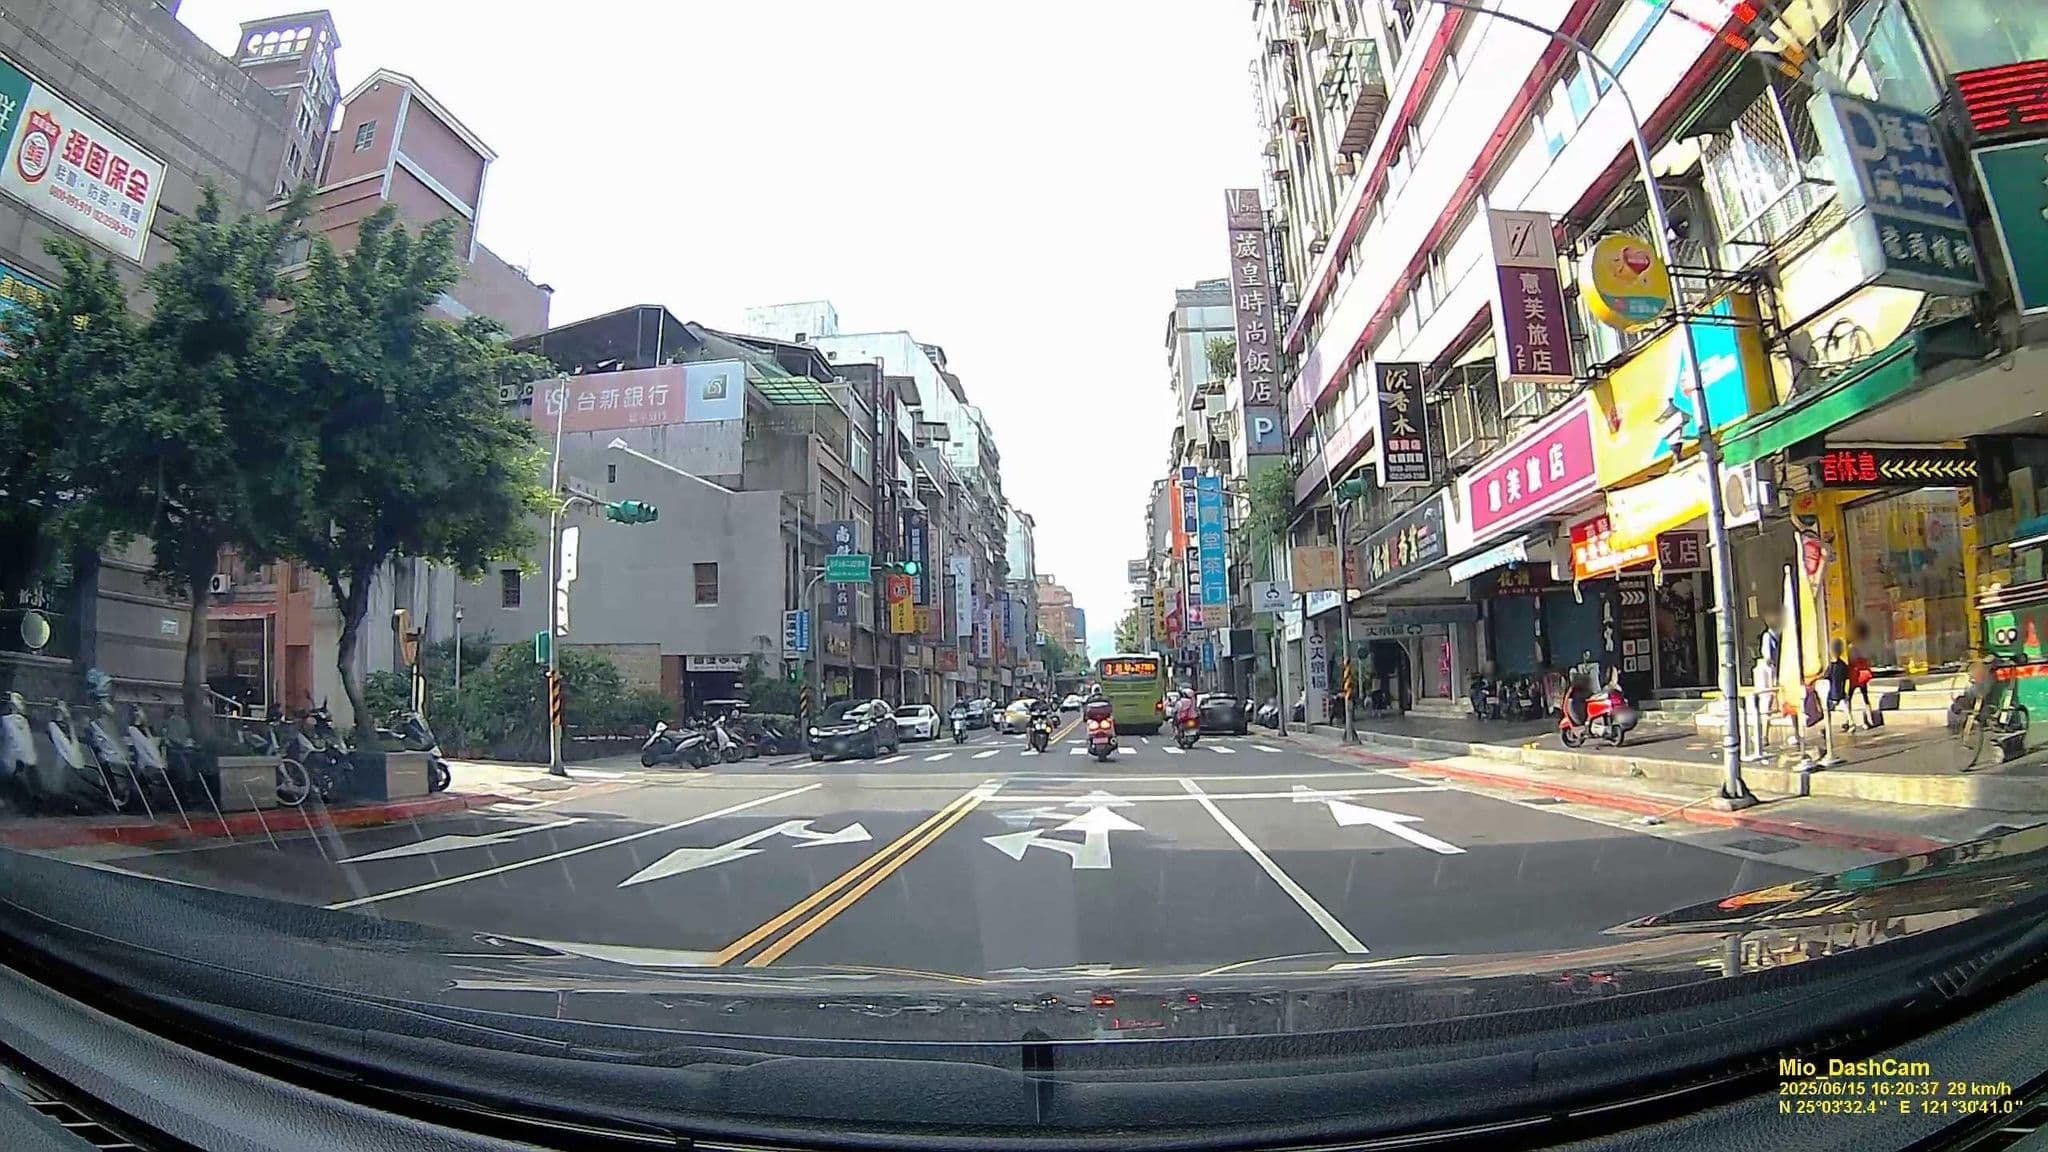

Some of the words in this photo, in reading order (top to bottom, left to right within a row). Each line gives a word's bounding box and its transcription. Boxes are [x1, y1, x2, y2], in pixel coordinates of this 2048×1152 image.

[577, 384, 669, 411] 台新銀行
[1385, 368, 1418, 437] 沉香木
[1254, 416, 1273, 444] P
